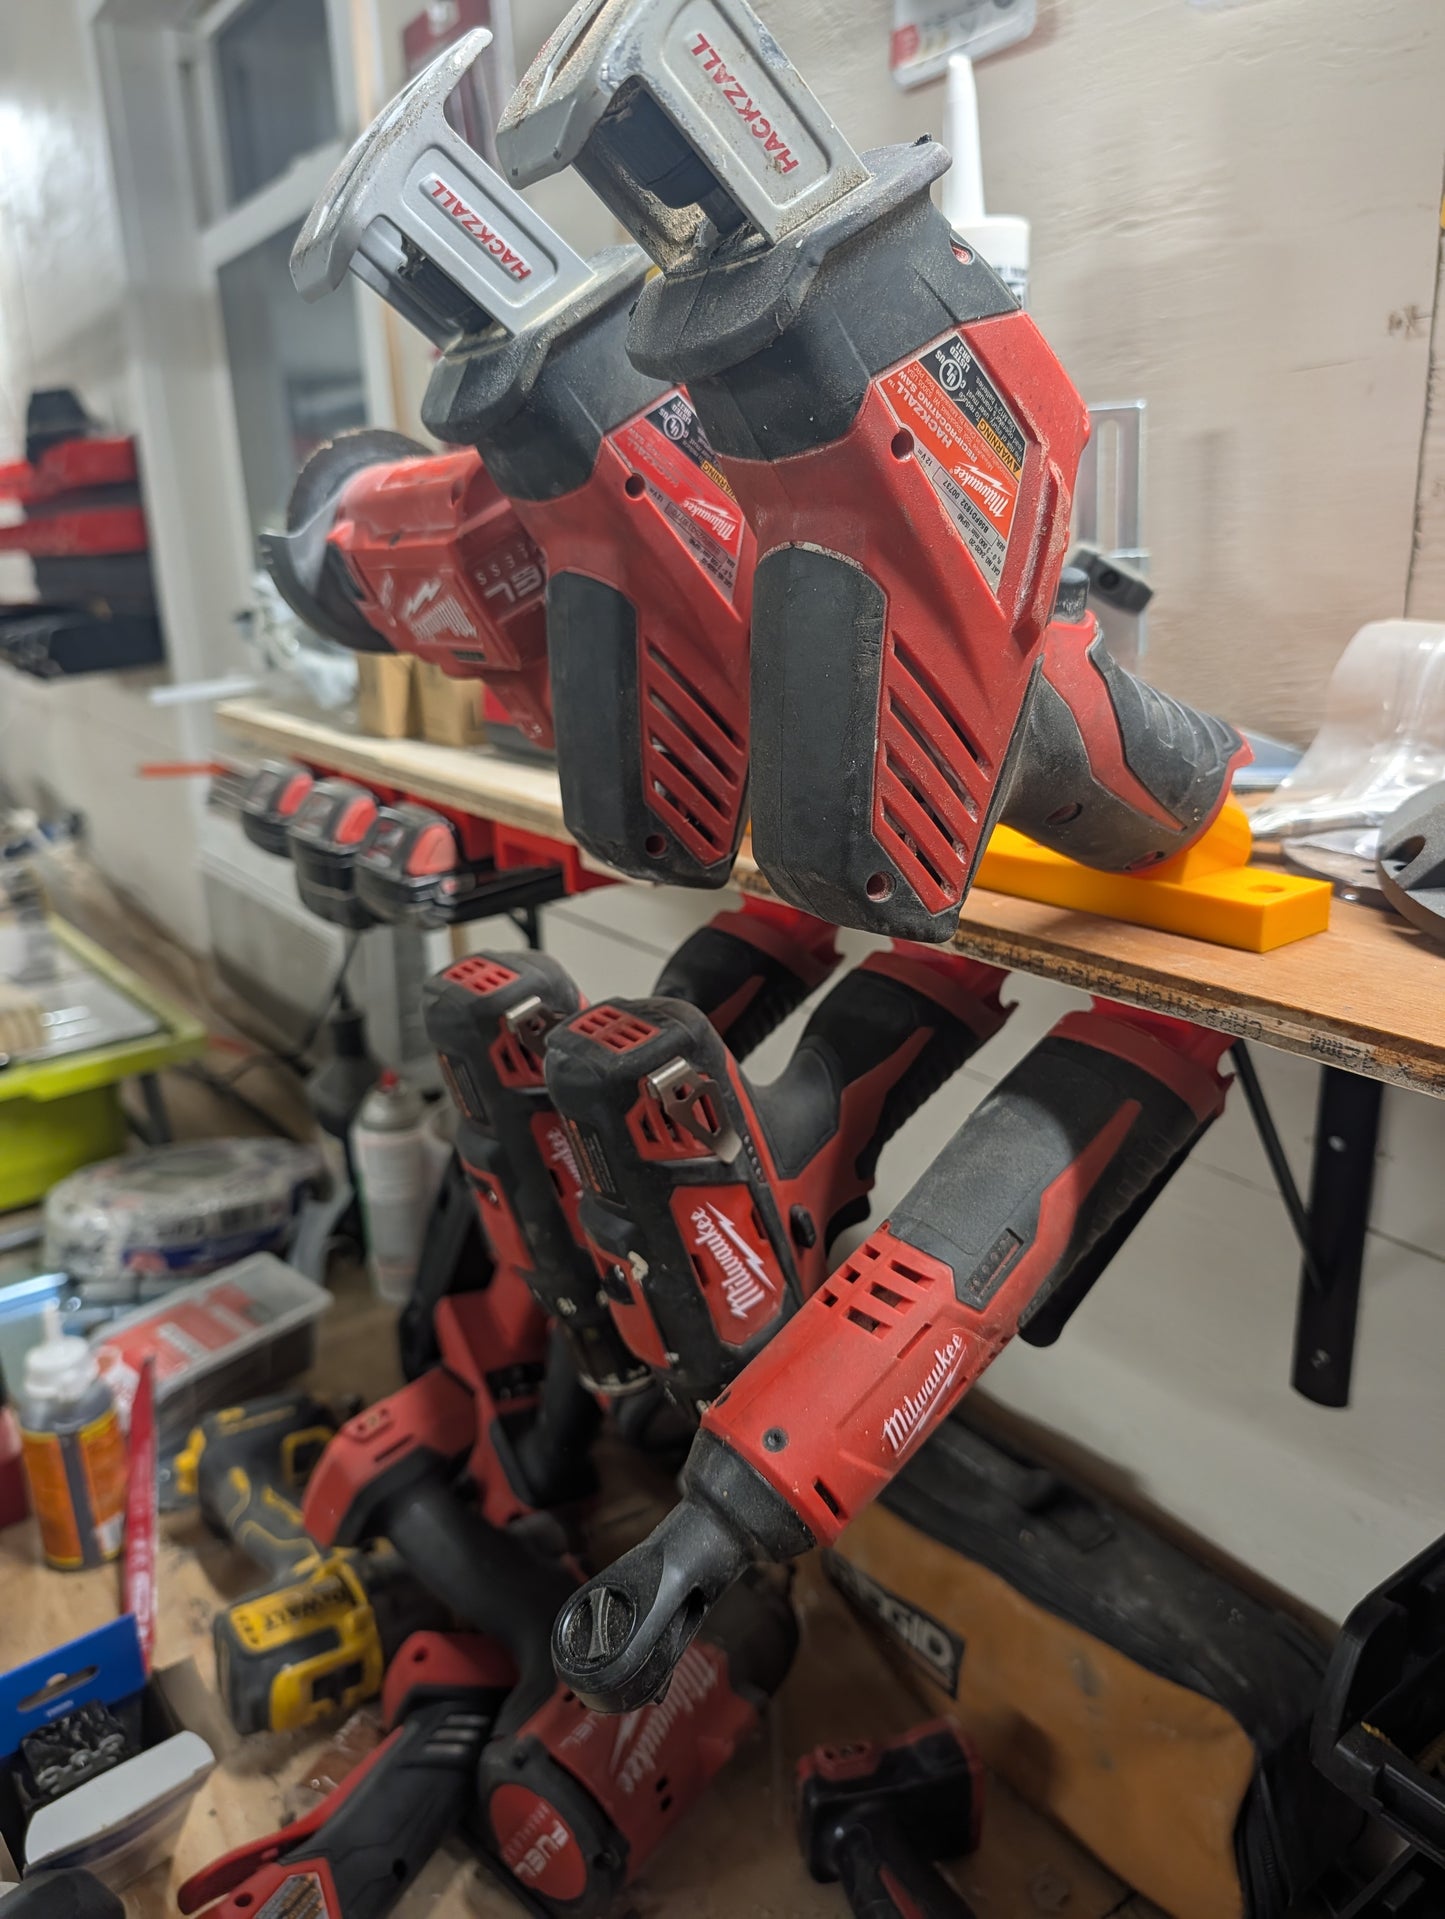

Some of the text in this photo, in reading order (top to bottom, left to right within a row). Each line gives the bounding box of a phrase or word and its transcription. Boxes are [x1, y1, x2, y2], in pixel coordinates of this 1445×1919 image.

[690, 32, 800, 174] HACKZALL
[432, 179, 532, 283] HACKZALL
[898, 368, 978, 464] RECIPROCATING SAW
[977, 420, 1015, 467] WARNING
[690, 1206, 766, 1321] Milwaukee
[882, 1331, 964, 1449] Milwaukee
[514, 1818, 570, 1880] FUEL
